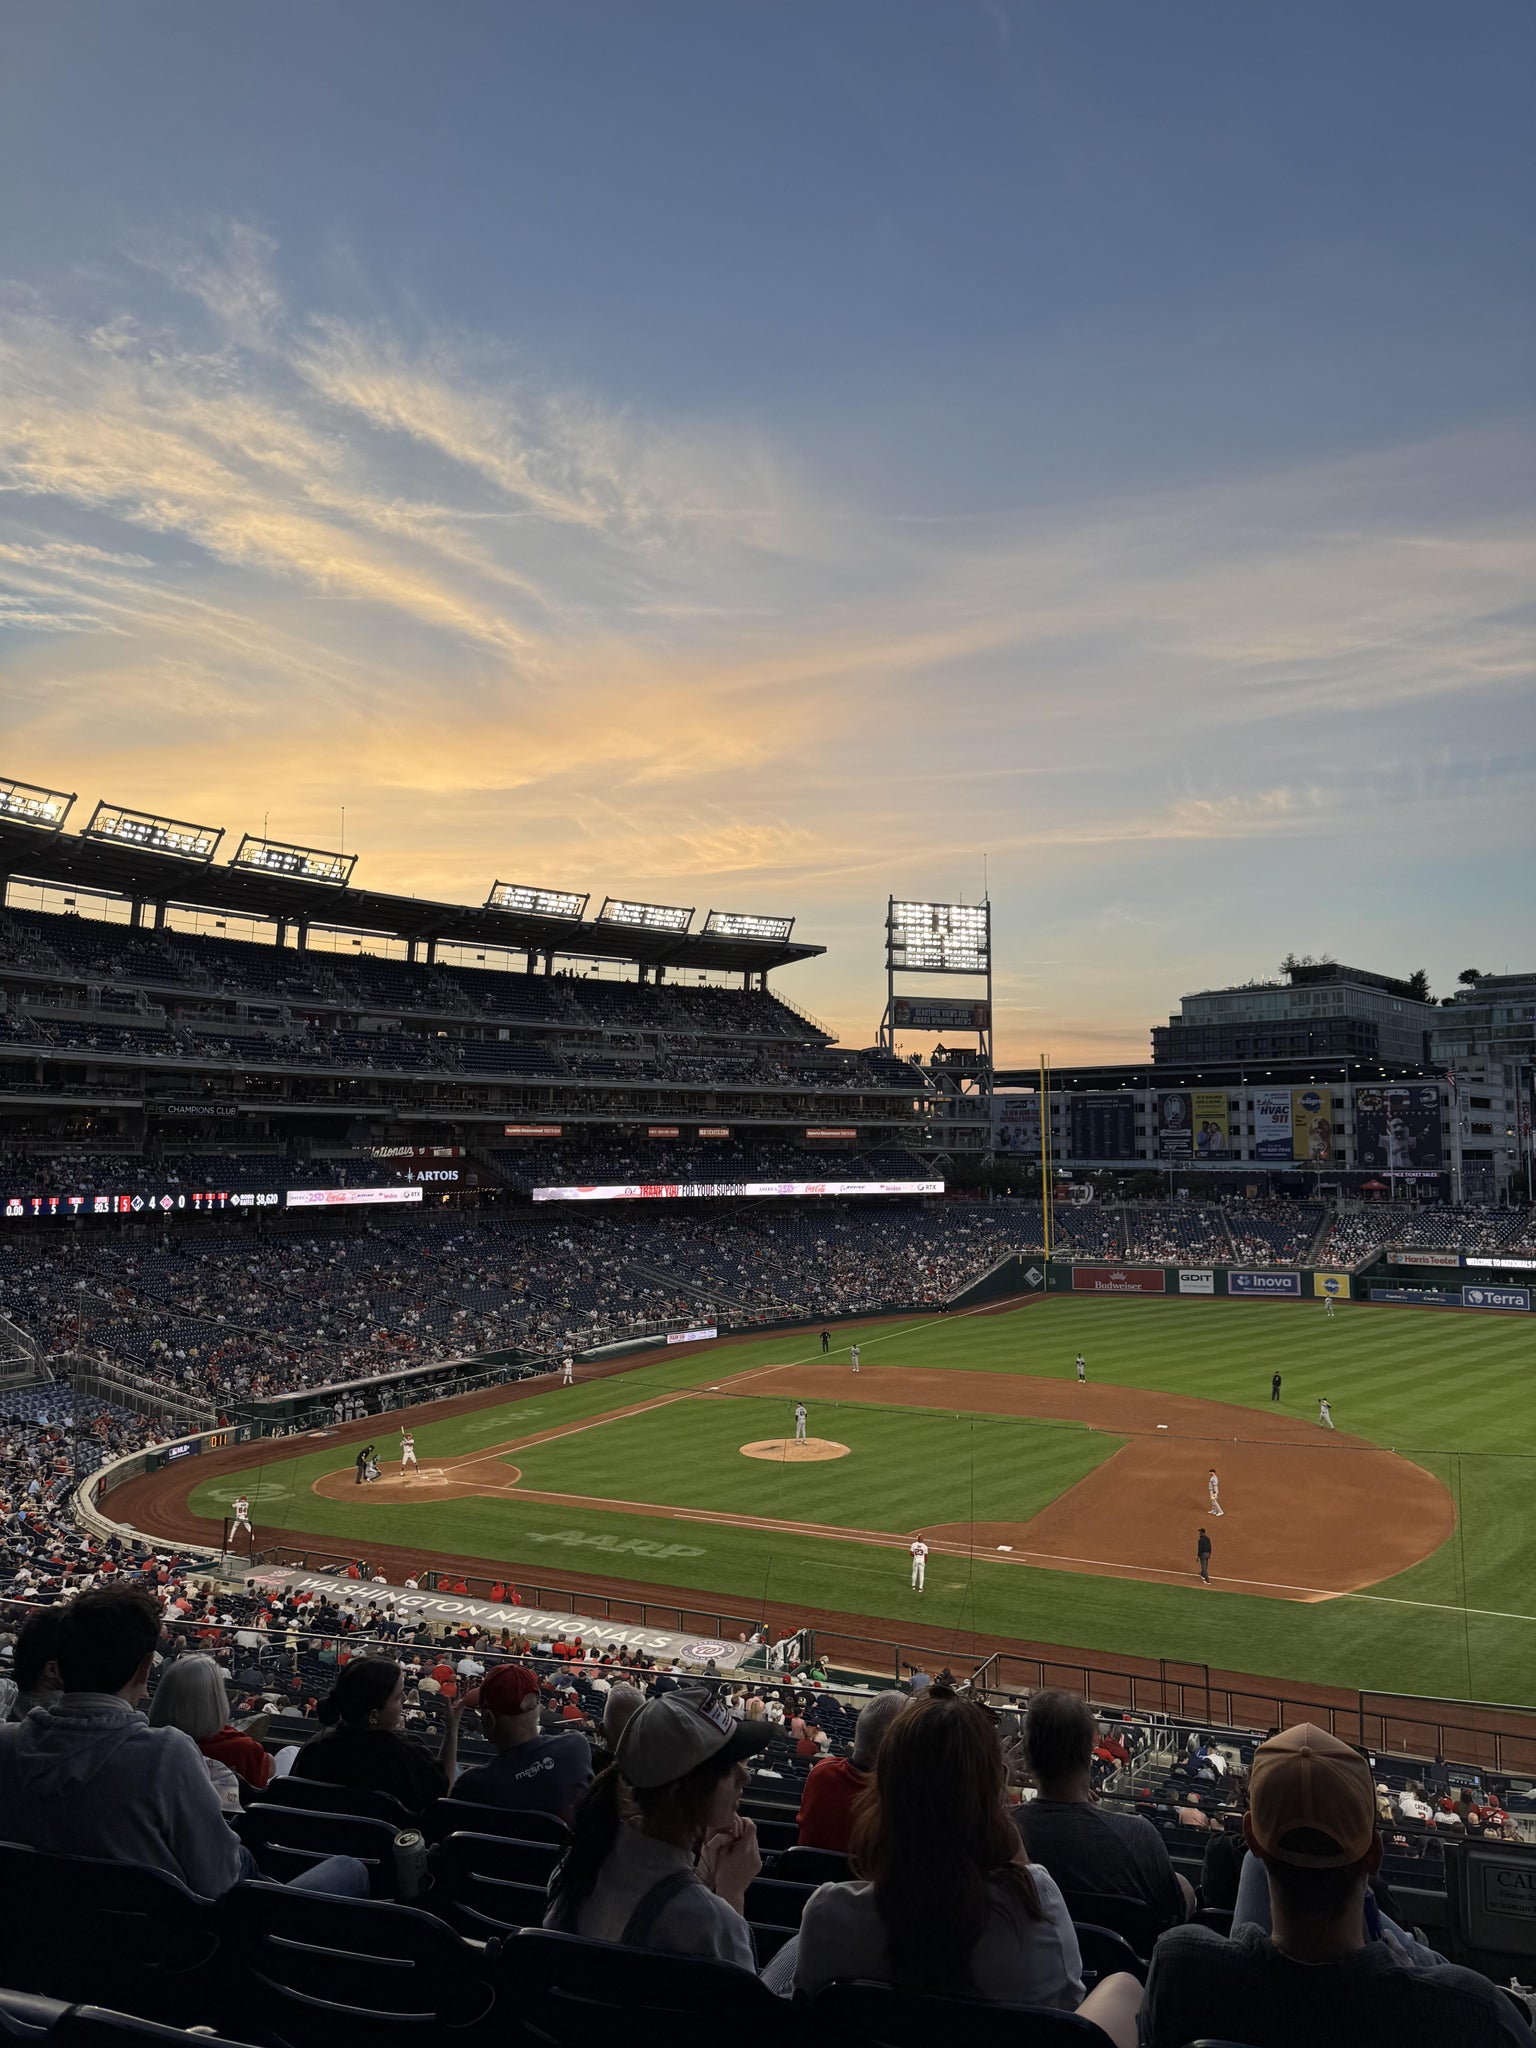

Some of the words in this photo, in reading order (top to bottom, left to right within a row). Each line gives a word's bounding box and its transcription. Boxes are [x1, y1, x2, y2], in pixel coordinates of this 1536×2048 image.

[915, 1008, 941, 1017] BEAUTIFUL
[942, 1009, 957, 1018] VIEWS
[958, 1010, 969, 1018] AND
[912, 1016, 931, 1024] AWARD
[954, 1018, 972, 1026] BREWS
[168, 1105, 215, 1115] CHAMPIONS
[216, 1106, 237, 1116] CLUB
[1261, 1106, 1290, 1115] HVAC
[1271, 1114, 1289, 1124] 911
[416, 1170, 459, 1181] ARTOIS
[640, 1185, 663, 1198] THANK
[664, 1185, 679, 1197] YOU
[681, 1185, 694, 1197] FOR
[696, 1184, 715, 1196] YOUR
[716, 1184, 745, 1196] SUPPORT
[777, 1184, 794, 1194] 250
[149, 1195, 156, 1209] 4
[178, 1195, 185, 1208] 0
[256, 1193, 278, 1206] $8,620
[308, 1192, 325, 1203] 250
[73, 1204, 79, 1213] 7
[94, 1202, 109, 1213] 90.5
[195, 1200, 200, 1209] 2
[207, 1200, 213, 1209] 2
[220, 1199, 225, 1208] 1
[6, 1205, 24, 1216] 0.00
[33, 1205, 39, 1215] 2
[51, 1204, 57, 1214] 5
[1404, 1255, 1430, 1263] Harris
[1430, 1256, 1457, 1265] Teeter
[1466, 1257, 1493, 1267] WELCOME
[1493, 1258, 1500, 1267] TO
[1500, 1259, 1532, 1269] NATIONALS
[1180, 1274, 1212, 1282] GDIT
[1253, 1275, 1292, 1288] Inova
[1094, 1280, 1143, 1290] Budweiser
[1483, 1291, 1525, 1306] Terra
[546, 1530, 707, 1558] AARP
[914, 1548, 924, 1556] 23
[296, 1578, 488, 1617] WASHINGTON
[486, 1610, 671, 1648] NATIONALS
